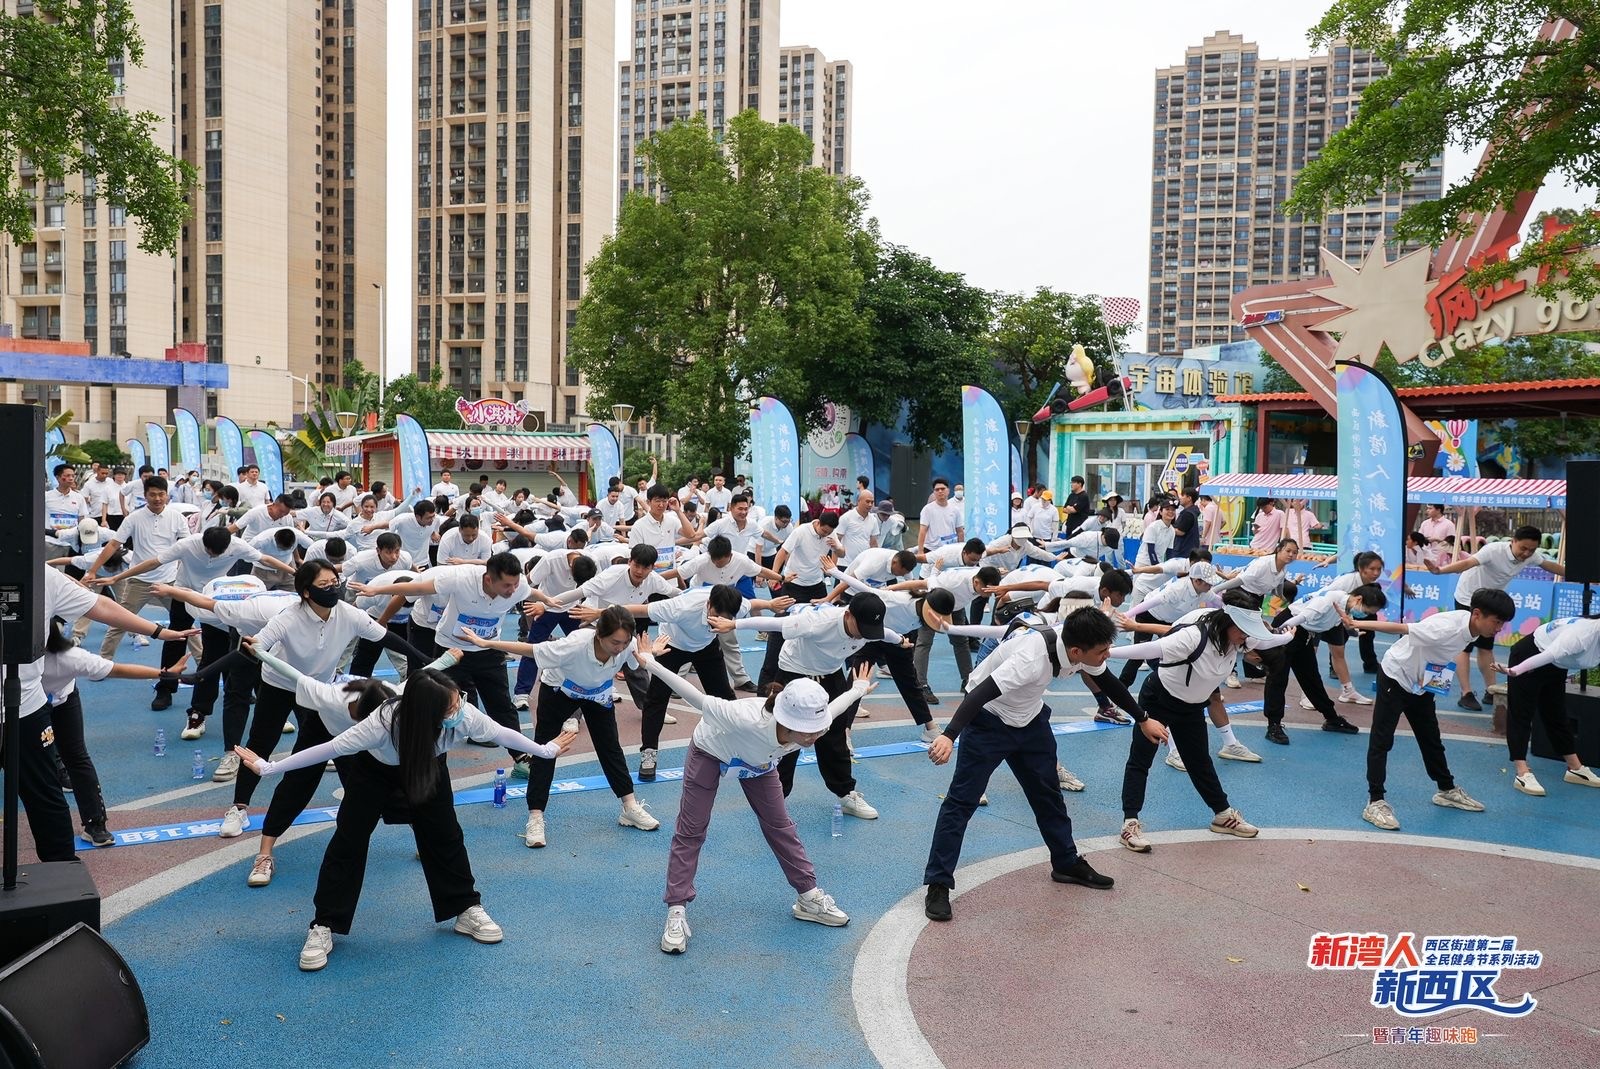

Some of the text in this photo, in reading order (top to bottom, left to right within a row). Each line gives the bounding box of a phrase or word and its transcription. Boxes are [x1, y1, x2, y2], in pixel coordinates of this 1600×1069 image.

[1418, 298, 1600, 368] Crazy go
[1128, 362, 1254, 396] 宇宙体验馆
[456, 447, 568, 460] 冰淇淋
